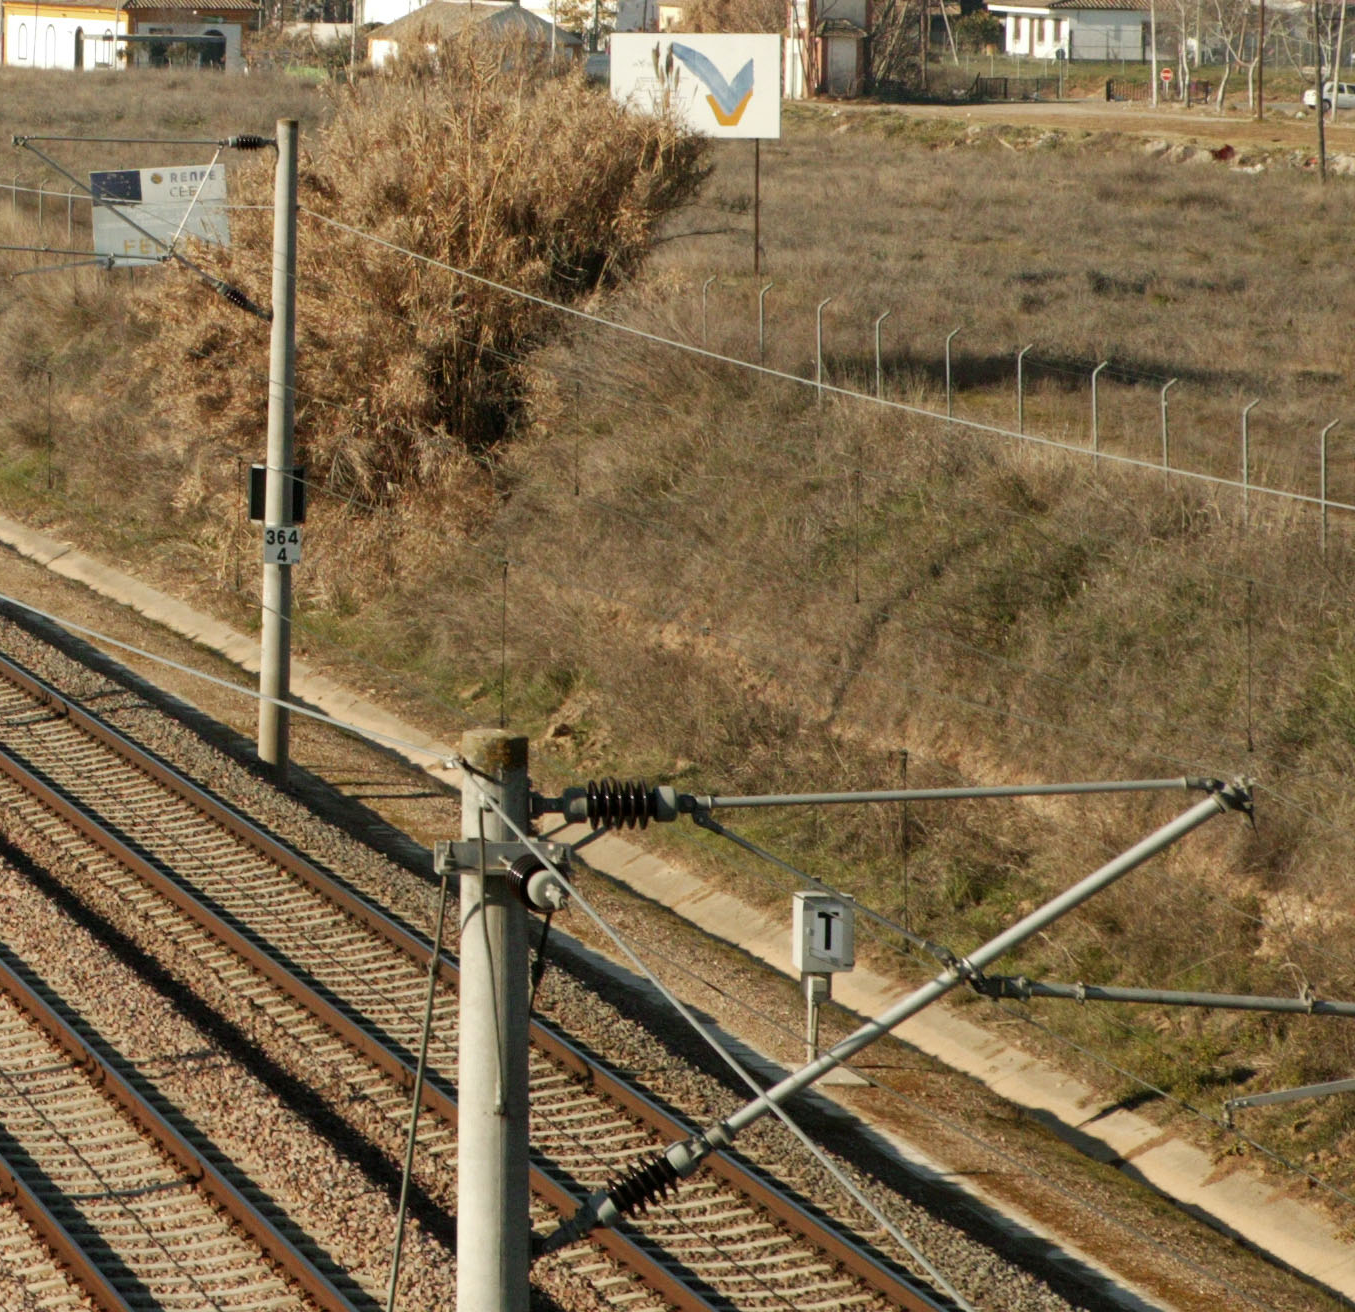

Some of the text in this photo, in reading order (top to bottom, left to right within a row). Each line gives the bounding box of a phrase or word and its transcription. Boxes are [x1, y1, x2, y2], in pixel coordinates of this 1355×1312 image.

[266, 530, 298, 545] 364
[277, 547, 287, 562] 4
[817, 911, 840, 950] T
